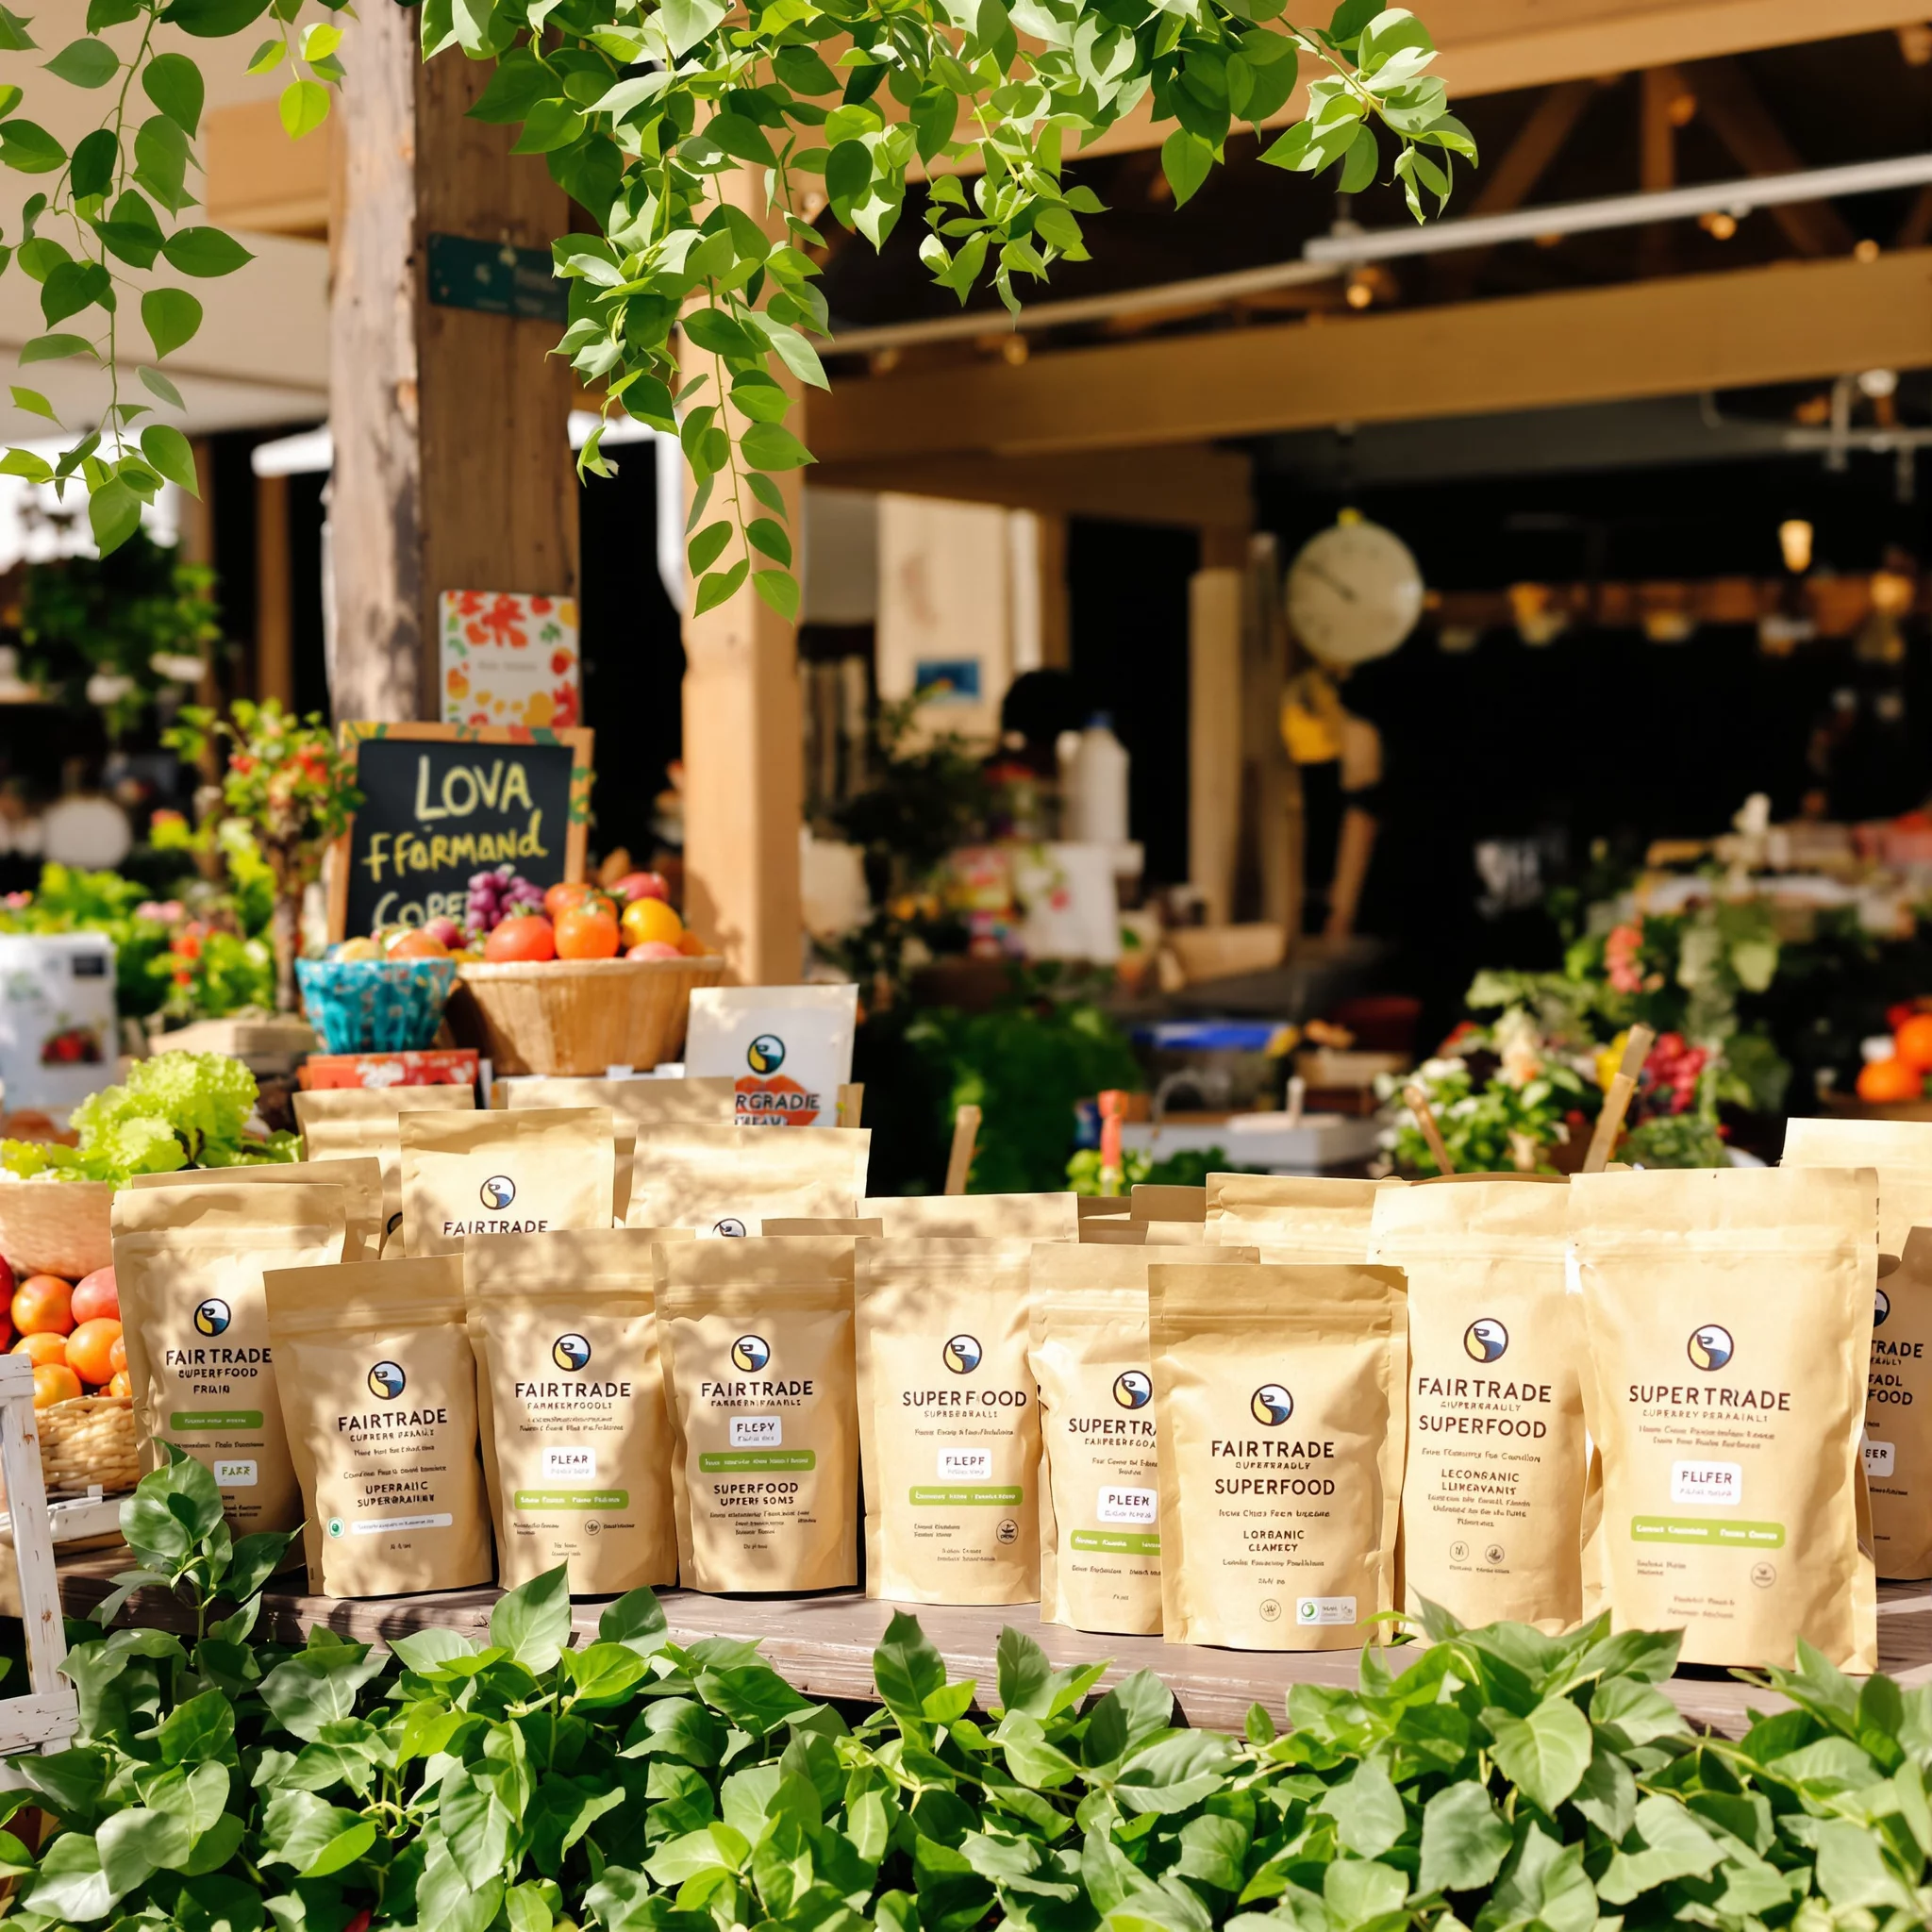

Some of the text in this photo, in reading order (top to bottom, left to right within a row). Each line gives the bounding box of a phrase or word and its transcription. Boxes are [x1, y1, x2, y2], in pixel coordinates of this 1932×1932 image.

[415, 755, 534, 821] LOVA
[443, 1220, 548, 1235] FAIRTRADE
[515, 1382, 631, 1398] FAIRTRADE
[702, 1381, 813, 1397] FAIRTRADE
[1419, 1377, 1552, 1403] FAIRTRADE
[903, 1391, 1027, 1407] SUPERFOOD
[338, 1408, 448, 1432] FAIRTRADE
[1069, 1418, 1157, 1436] SUPERTR
[1419, 1415, 1547, 1439] SUPERFOOD
[1211, 1441, 1334, 1458] FAIRTRADE
[714, 1482, 799, 1495] SUPERFOOD
[1215, 1479, 1336, 1495] SUPERFOOD
